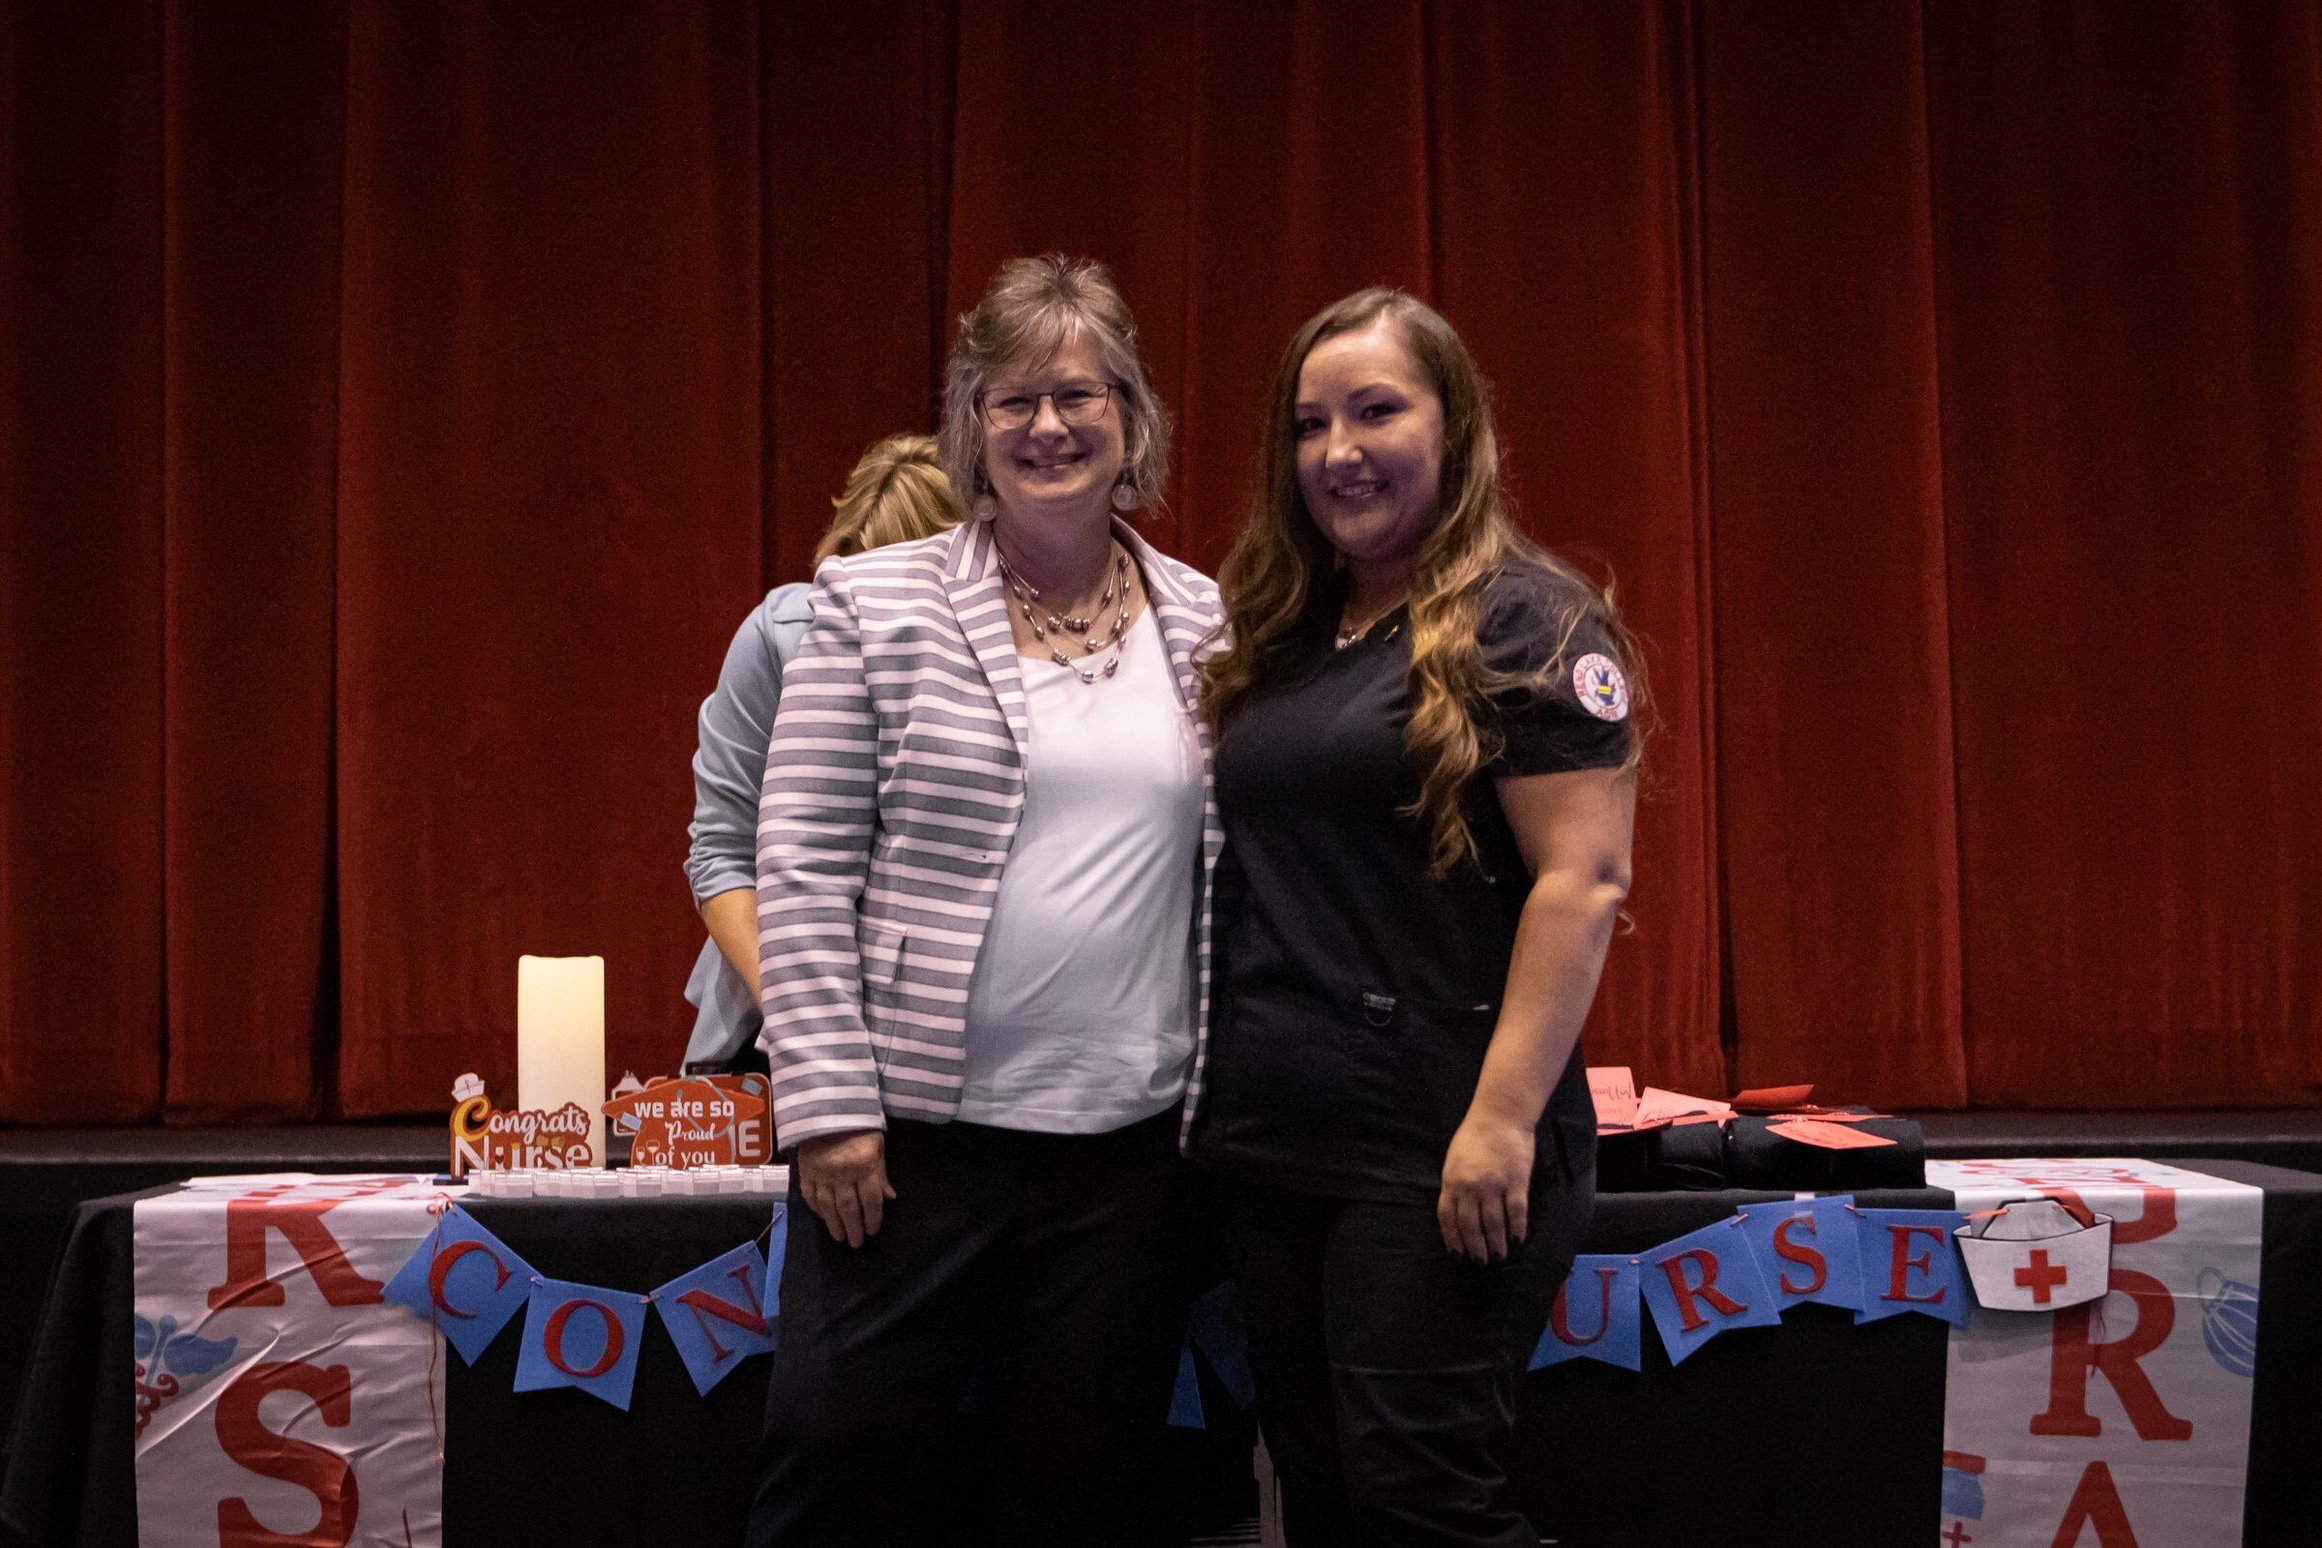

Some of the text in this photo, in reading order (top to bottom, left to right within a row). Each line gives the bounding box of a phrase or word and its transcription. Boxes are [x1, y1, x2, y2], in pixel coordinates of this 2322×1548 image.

[453, 1095, 587, 1144] Congrats
[634, 1101, 735, 1118] we are so
[665, 1121, 716, 1145] Proud
[454, 1135, 591, 1177] Nurse
[655, 1146, 716, 1170] of you
